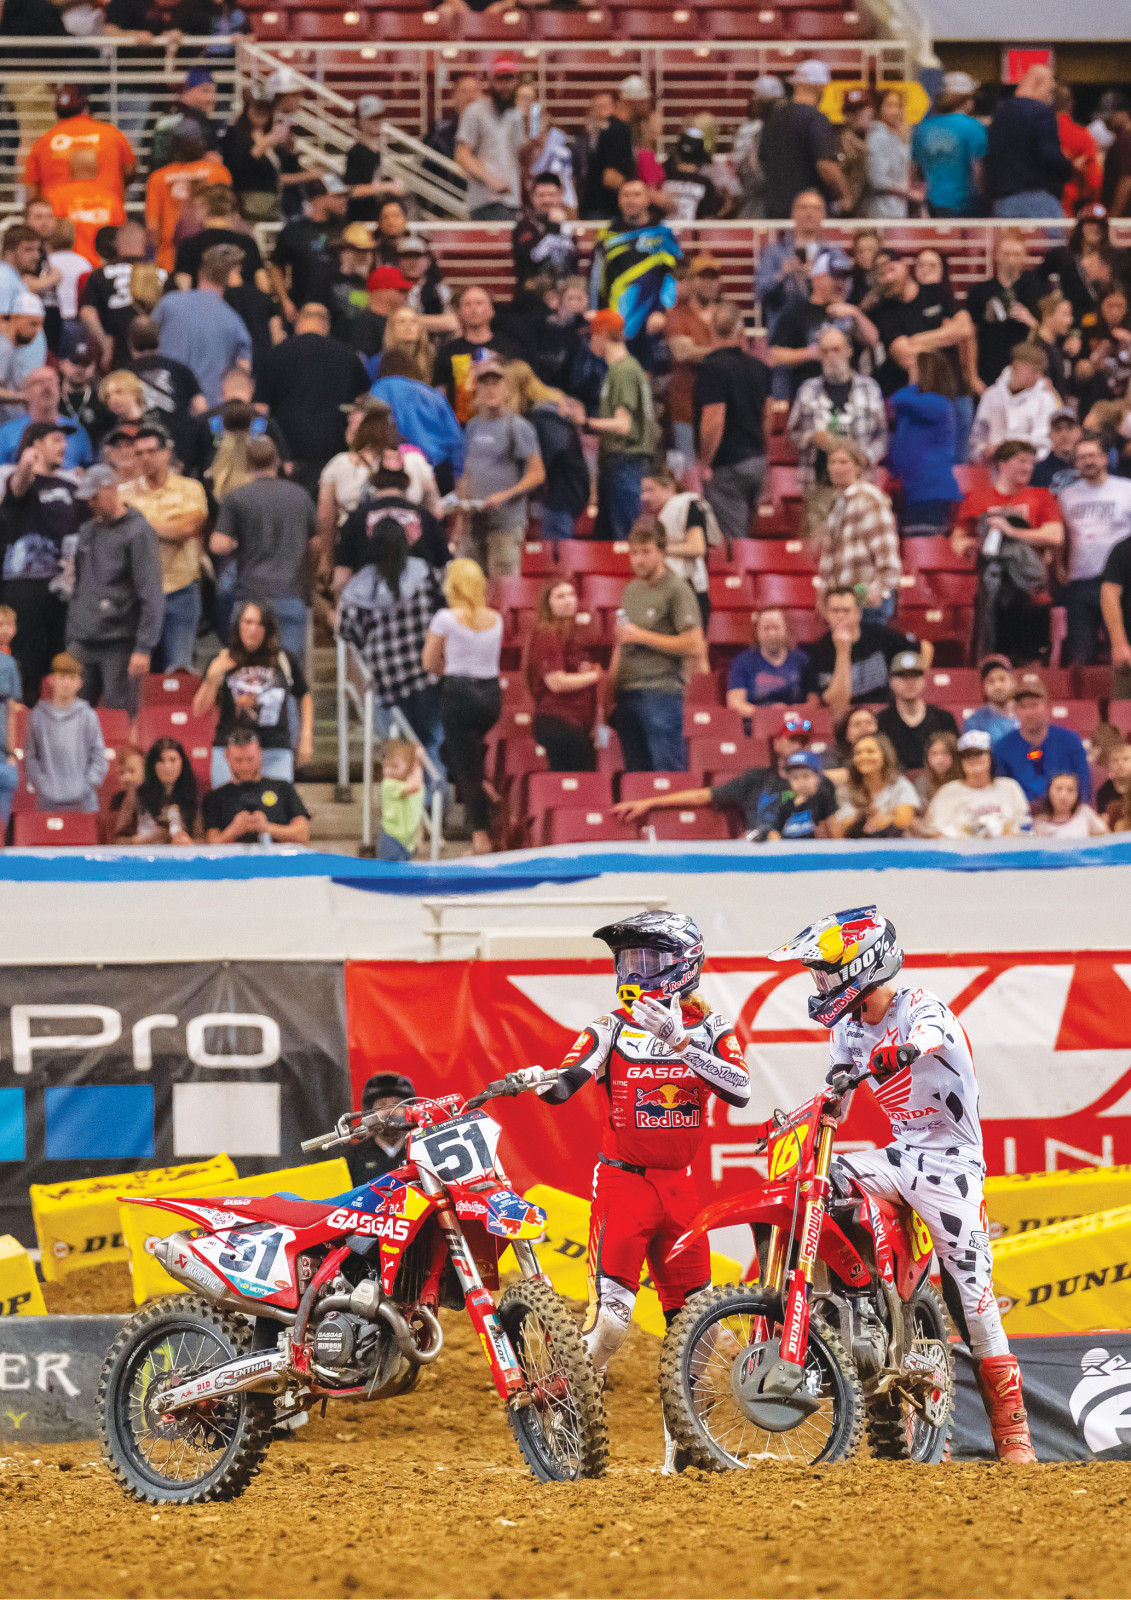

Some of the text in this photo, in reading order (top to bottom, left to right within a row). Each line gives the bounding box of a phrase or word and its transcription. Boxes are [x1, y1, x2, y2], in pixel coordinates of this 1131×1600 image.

[839, 935, 889, 981] 100%
[669, 972, 686, 992] Red
[818, 986, 860, 1025] Red Bull
[626, 1067, 699, 1079] GASGA
[701, 1059, 720, 1076] Lee
[636, 1109, 700, 1128] Red Bull
[422, 1122, 494, 1182] 51
[770, 1123, 809, 1181] 18
[326, 1208, 410, 1241] GASGAS
[804, 1204, 822, 1262] SHOWA
[911, 1209, 934, 1262] 18
[219, 1230, 284, 1282] 51
[788, 1290, 804, 1355] DUNLOP
[197, 1380, 211, 1392] DID
